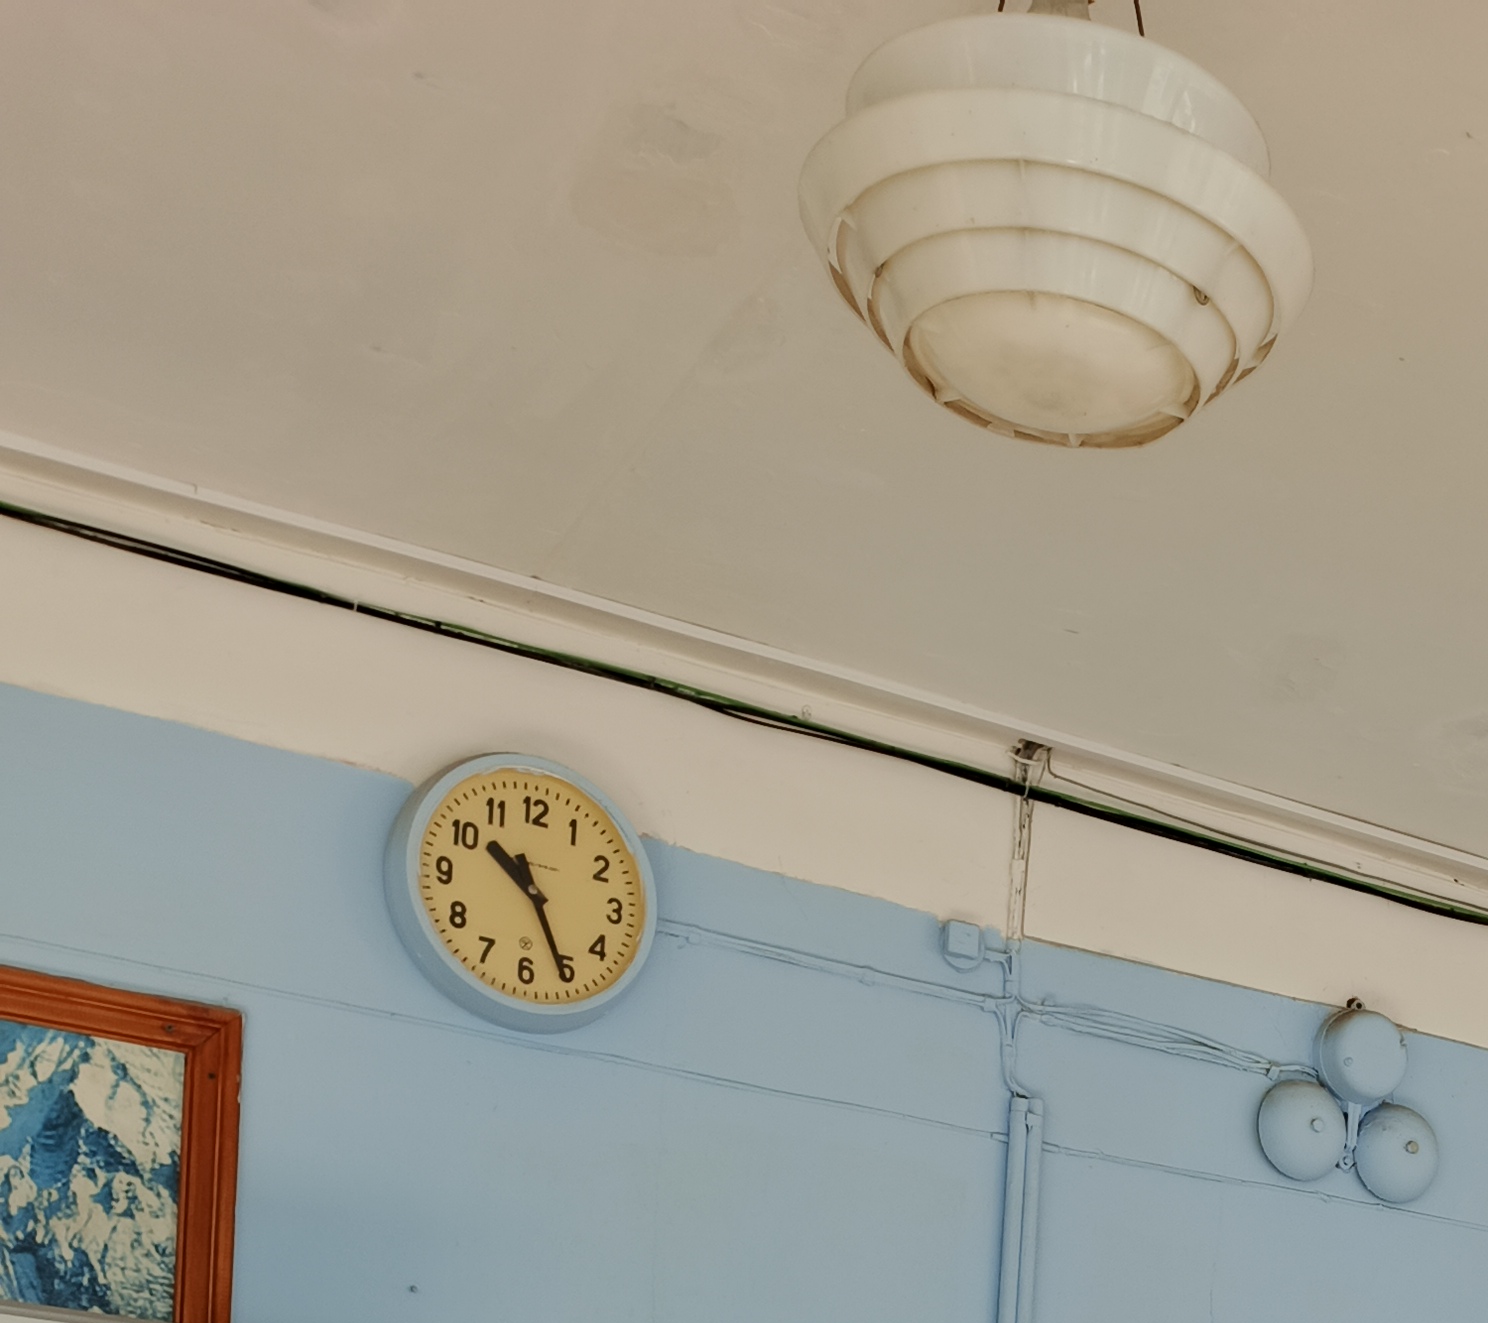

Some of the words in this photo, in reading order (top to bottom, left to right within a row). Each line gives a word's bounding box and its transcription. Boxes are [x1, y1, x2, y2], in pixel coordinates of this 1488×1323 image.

[486, 797, 506, 828] 11
[523, 796, 549, 828] 12
[452, 819, 479, 850] 10
[569, 819, 577, 846] 1
[435, 856, 453, 884] 9
[592, 855, 610, 883] 2
[449, 901, 467, 928] 8
[606, 897, 622, 924] 3
[478, 936, 495, 963] 7
[588, 934, 606, 961] 4
[517, 957, 534, 984] 6
